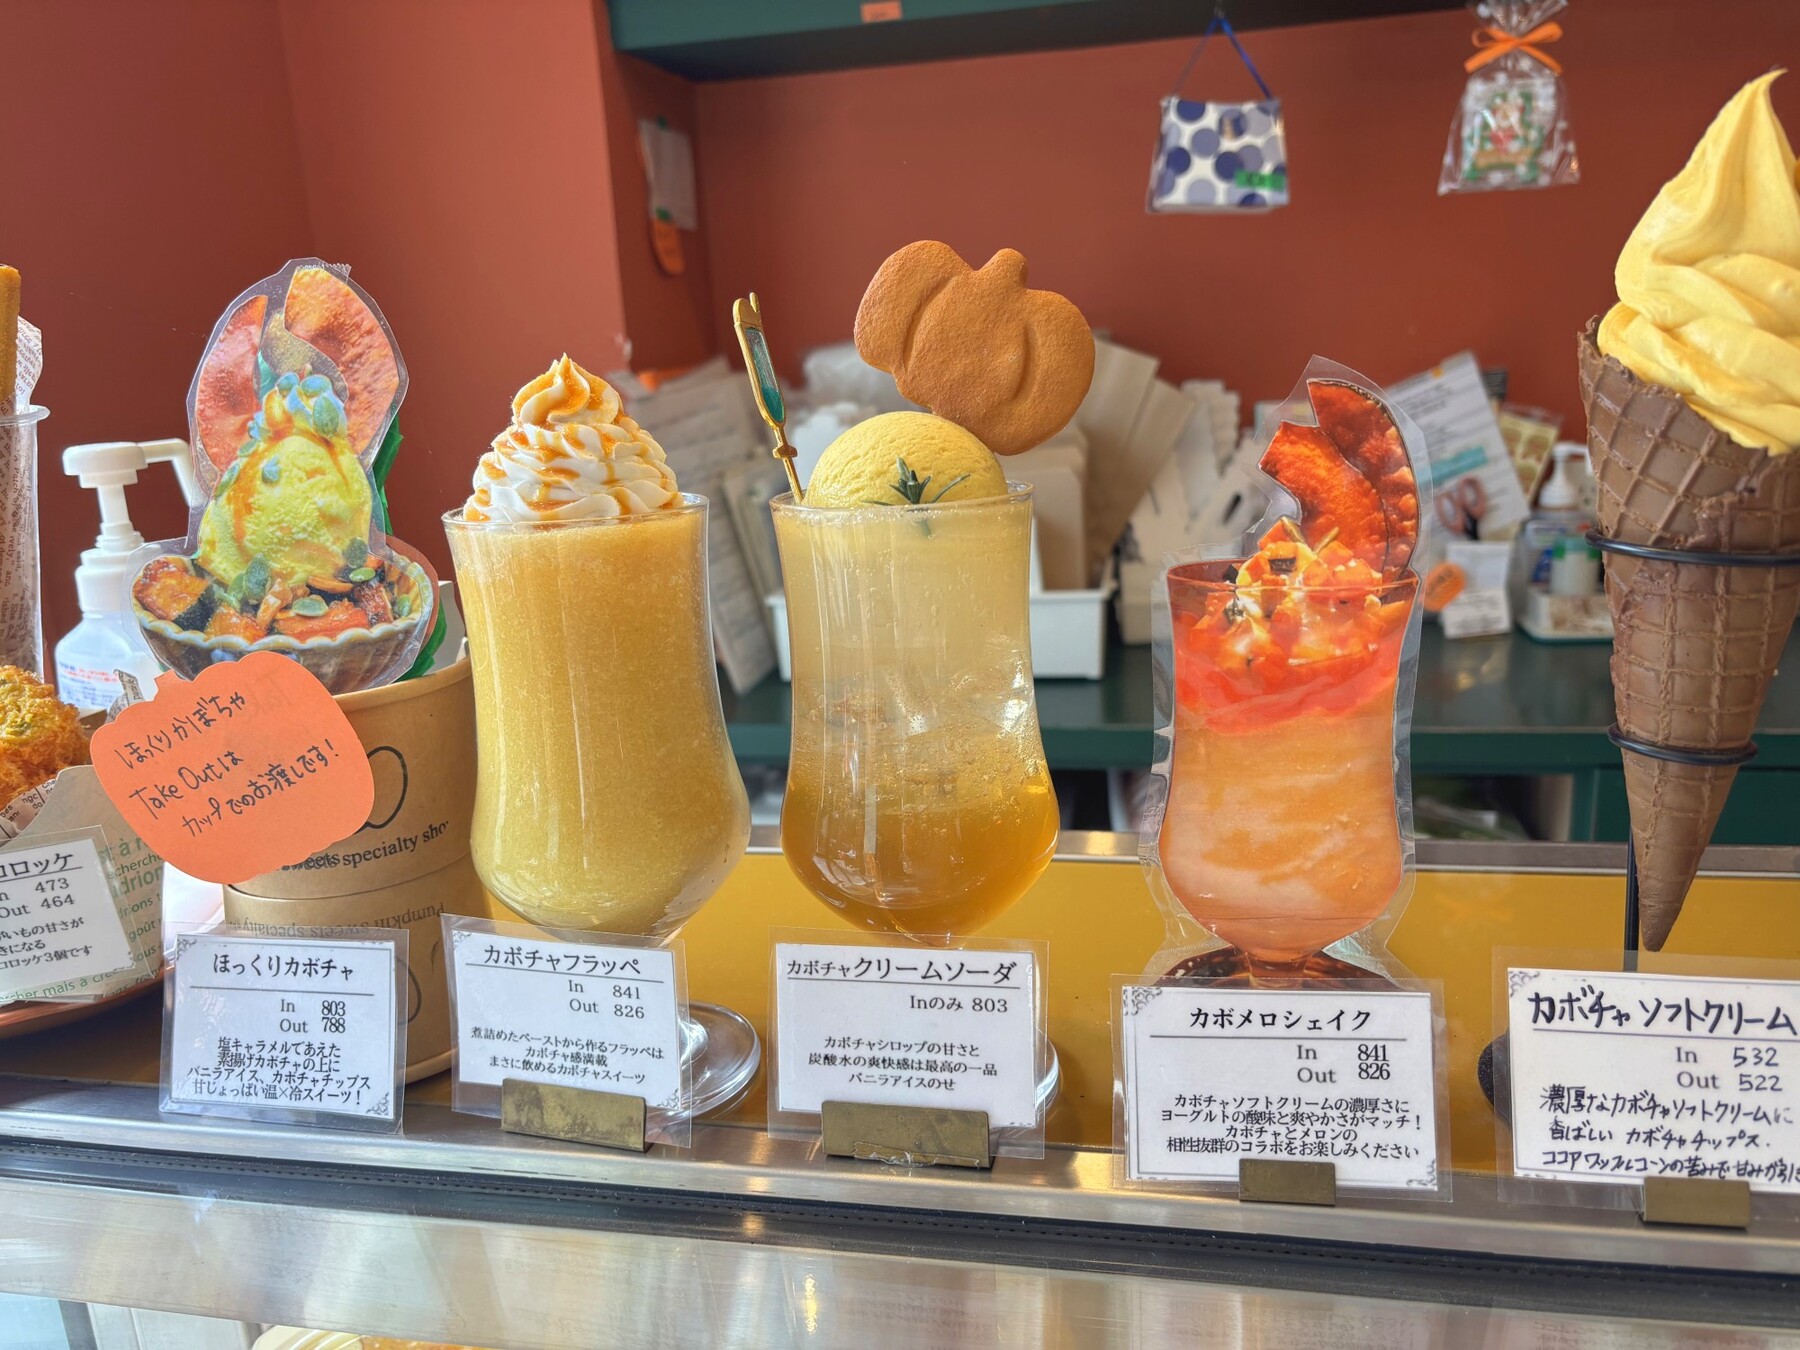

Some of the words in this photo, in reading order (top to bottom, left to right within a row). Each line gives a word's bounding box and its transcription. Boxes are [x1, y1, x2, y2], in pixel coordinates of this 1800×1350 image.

[114, 692, 246, 770] ほっくりかぼちゃ
[128, 783, 184, 820] Take
[342, 834, 418, 869] specialty
[422, 820, 450, 843] sho
[35, 877, 70, 893] 473
[0, 904, 31, 919] Out
[40, 893, 75, 909] 464
[212, 952, 355, 982] ほっくりカボチャ
[484, 945, 641, 976] カボチャフラッペ
[787, 957, 1018, 985] カボチャクリームソーダ
[42, 981, 76, 998] mais
[568, 980, 584, 994] In
[612, 985, 641, 1000] 841
[280, 998, 296, 1013] In
[321, 1000, 346, 1017] 803
[569, 998, 599, 1014] Out
[613, 1004, 645, 1020] 826
[971, 997, 1008, 1013] 803
[279, 1019, 309, 1034] Out
[321, 1017, 346, 1034] 788
[1189, 1008, 1372, 1032] カボメロシェイク
[217, 1036, 342, 1059] 塩キャラメルであえた
[525, 1046, 608, 1068] カボチャ感満載
[824, 1036, 981, 1057] カボチャシロップの甘さと
[1297, 1044, 1317, 1060] In
[1357, 1043, 1390, 1063] 841
[1675, 1046, 1699, 1064] In
[1732, 1047, 1780, 1068] 532
[217, 1051, 341, 1074] 素揚げカボチャの上に
[489, 1055, 646, 1085] まさに飲めるカボチャスイーツ
[808, 1052, 998, 1077] 炭酸水の爽快感は最高の一品
[1296, 1067, 1337, 1084] Out
[1357, 1062, 1391, 1081] 826
[848, 1073, 956, 1091] バニラアイスのせ
[1677, 1071, 1719, 1090] Out
[1738, 1074, 1784, 1092] 522
[1174, 1093, 1410, 1115] カボチャソフトクリームの濃厚さに
[1539, 1084, 1794, 1126] 濃厚なカボチャソフトクリームに
[1225, 1124, 1358, 1142] カボチャとメロンの
[1166, 1135, 1419, 1160] 相性抜群のコラボをお楽しみください
